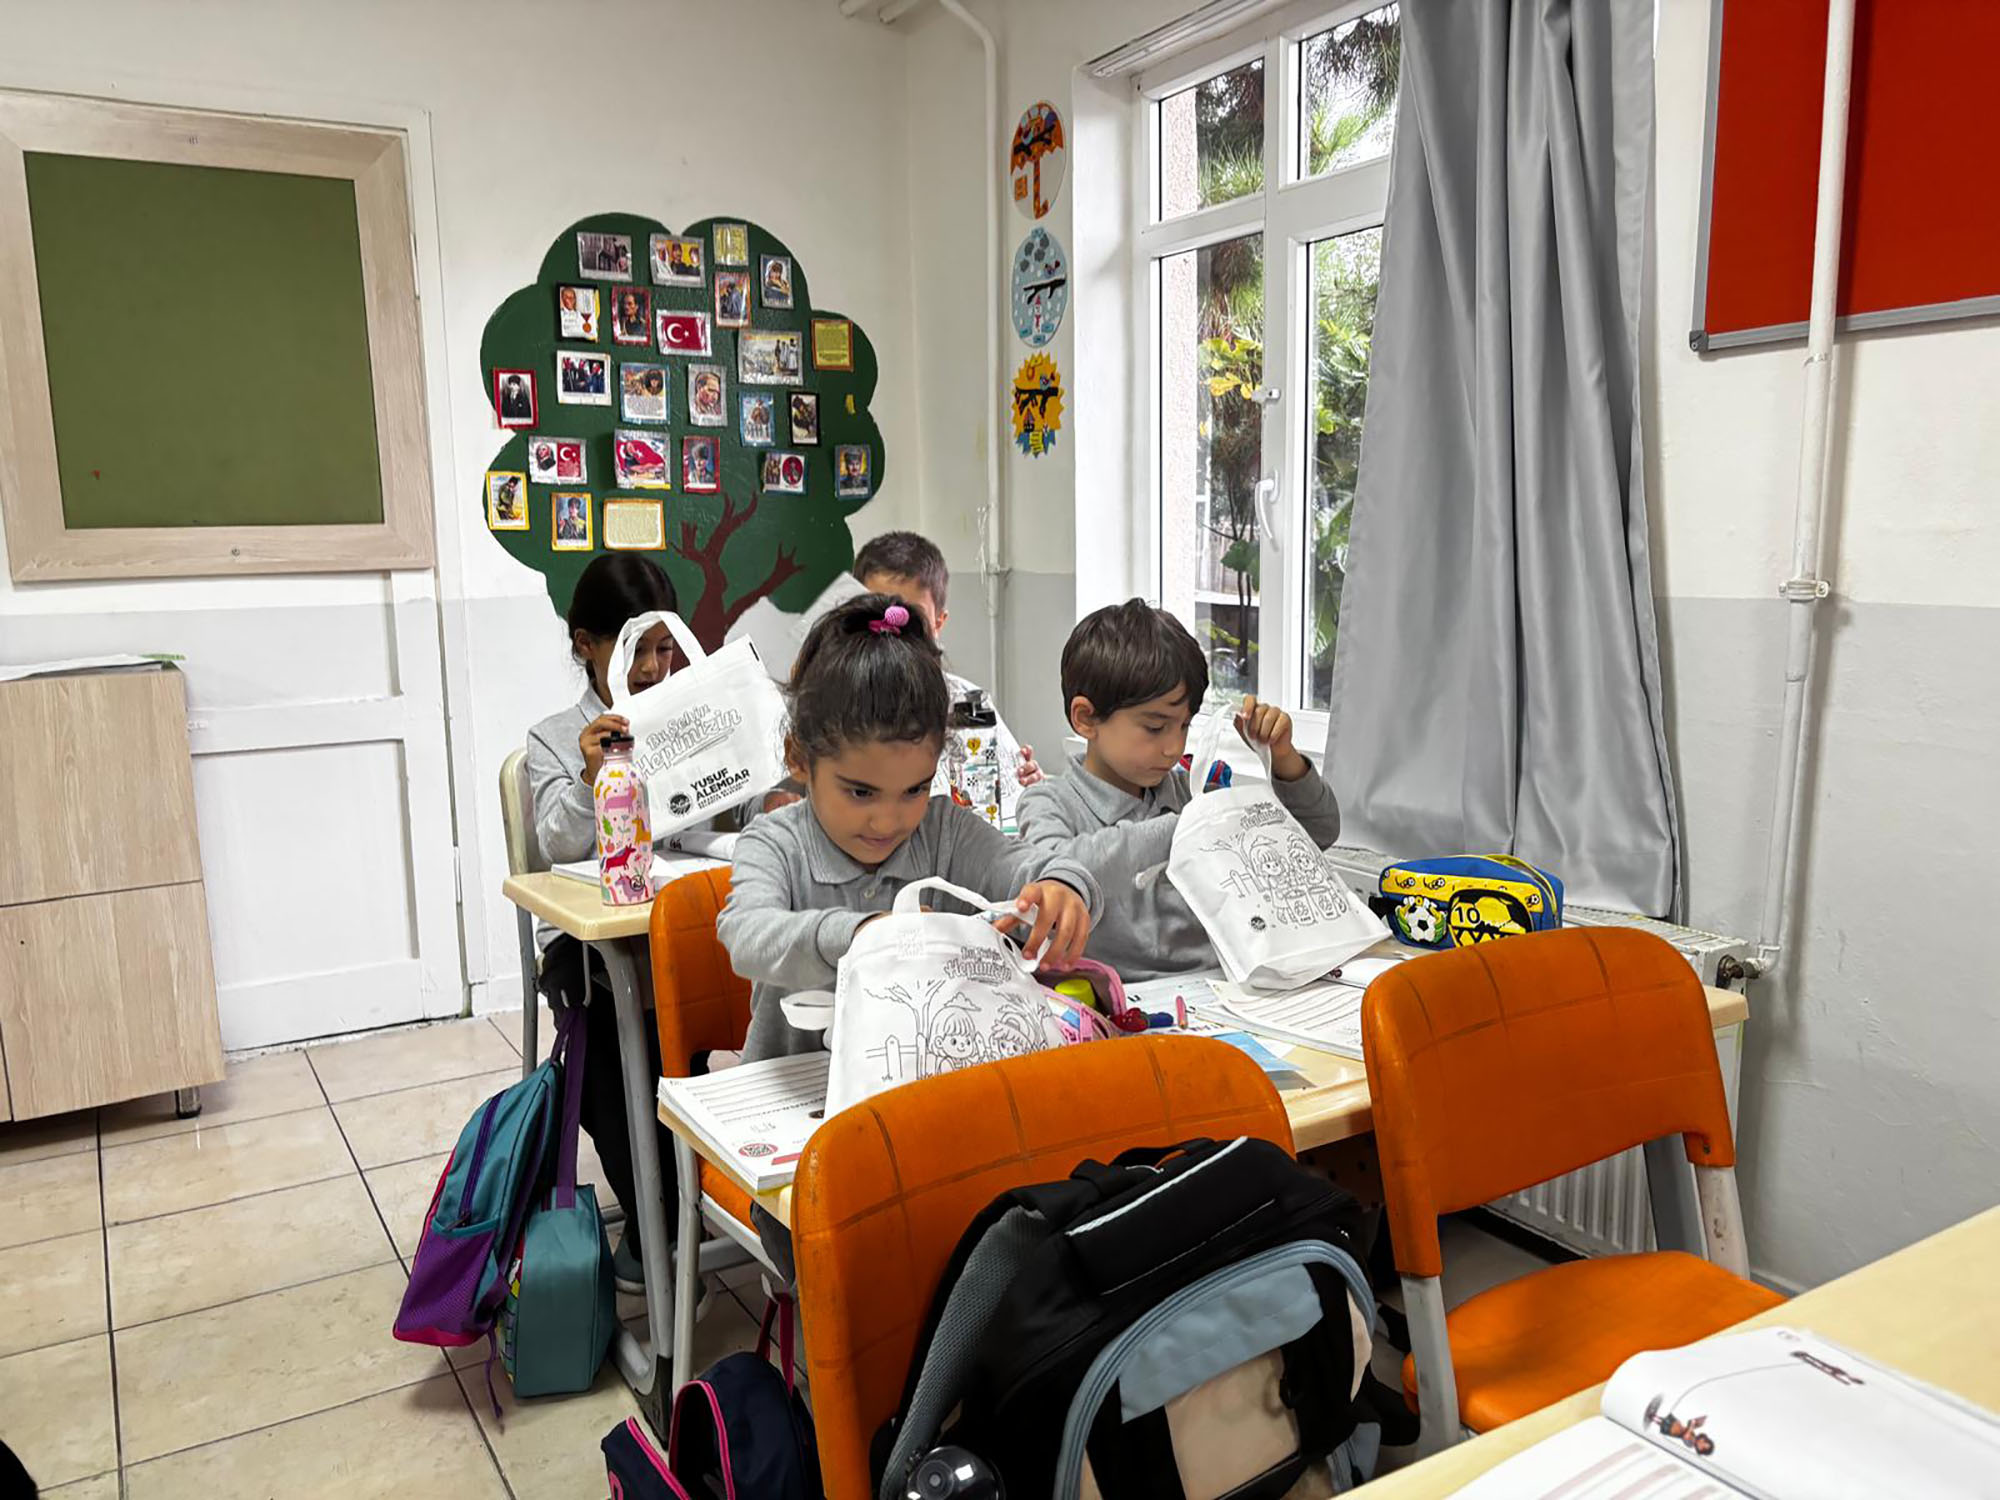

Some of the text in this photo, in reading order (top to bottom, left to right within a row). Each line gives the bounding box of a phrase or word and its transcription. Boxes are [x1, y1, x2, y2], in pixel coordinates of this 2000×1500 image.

[639, 708, 742, 780] Hepimizin
[690, 767, 728, 791] YUSUF
[696, 768, 750, 802] ALEMDAR
[1402, 895, 1438, 909] SPORT
[1455, 905, 1481, 925] 10
